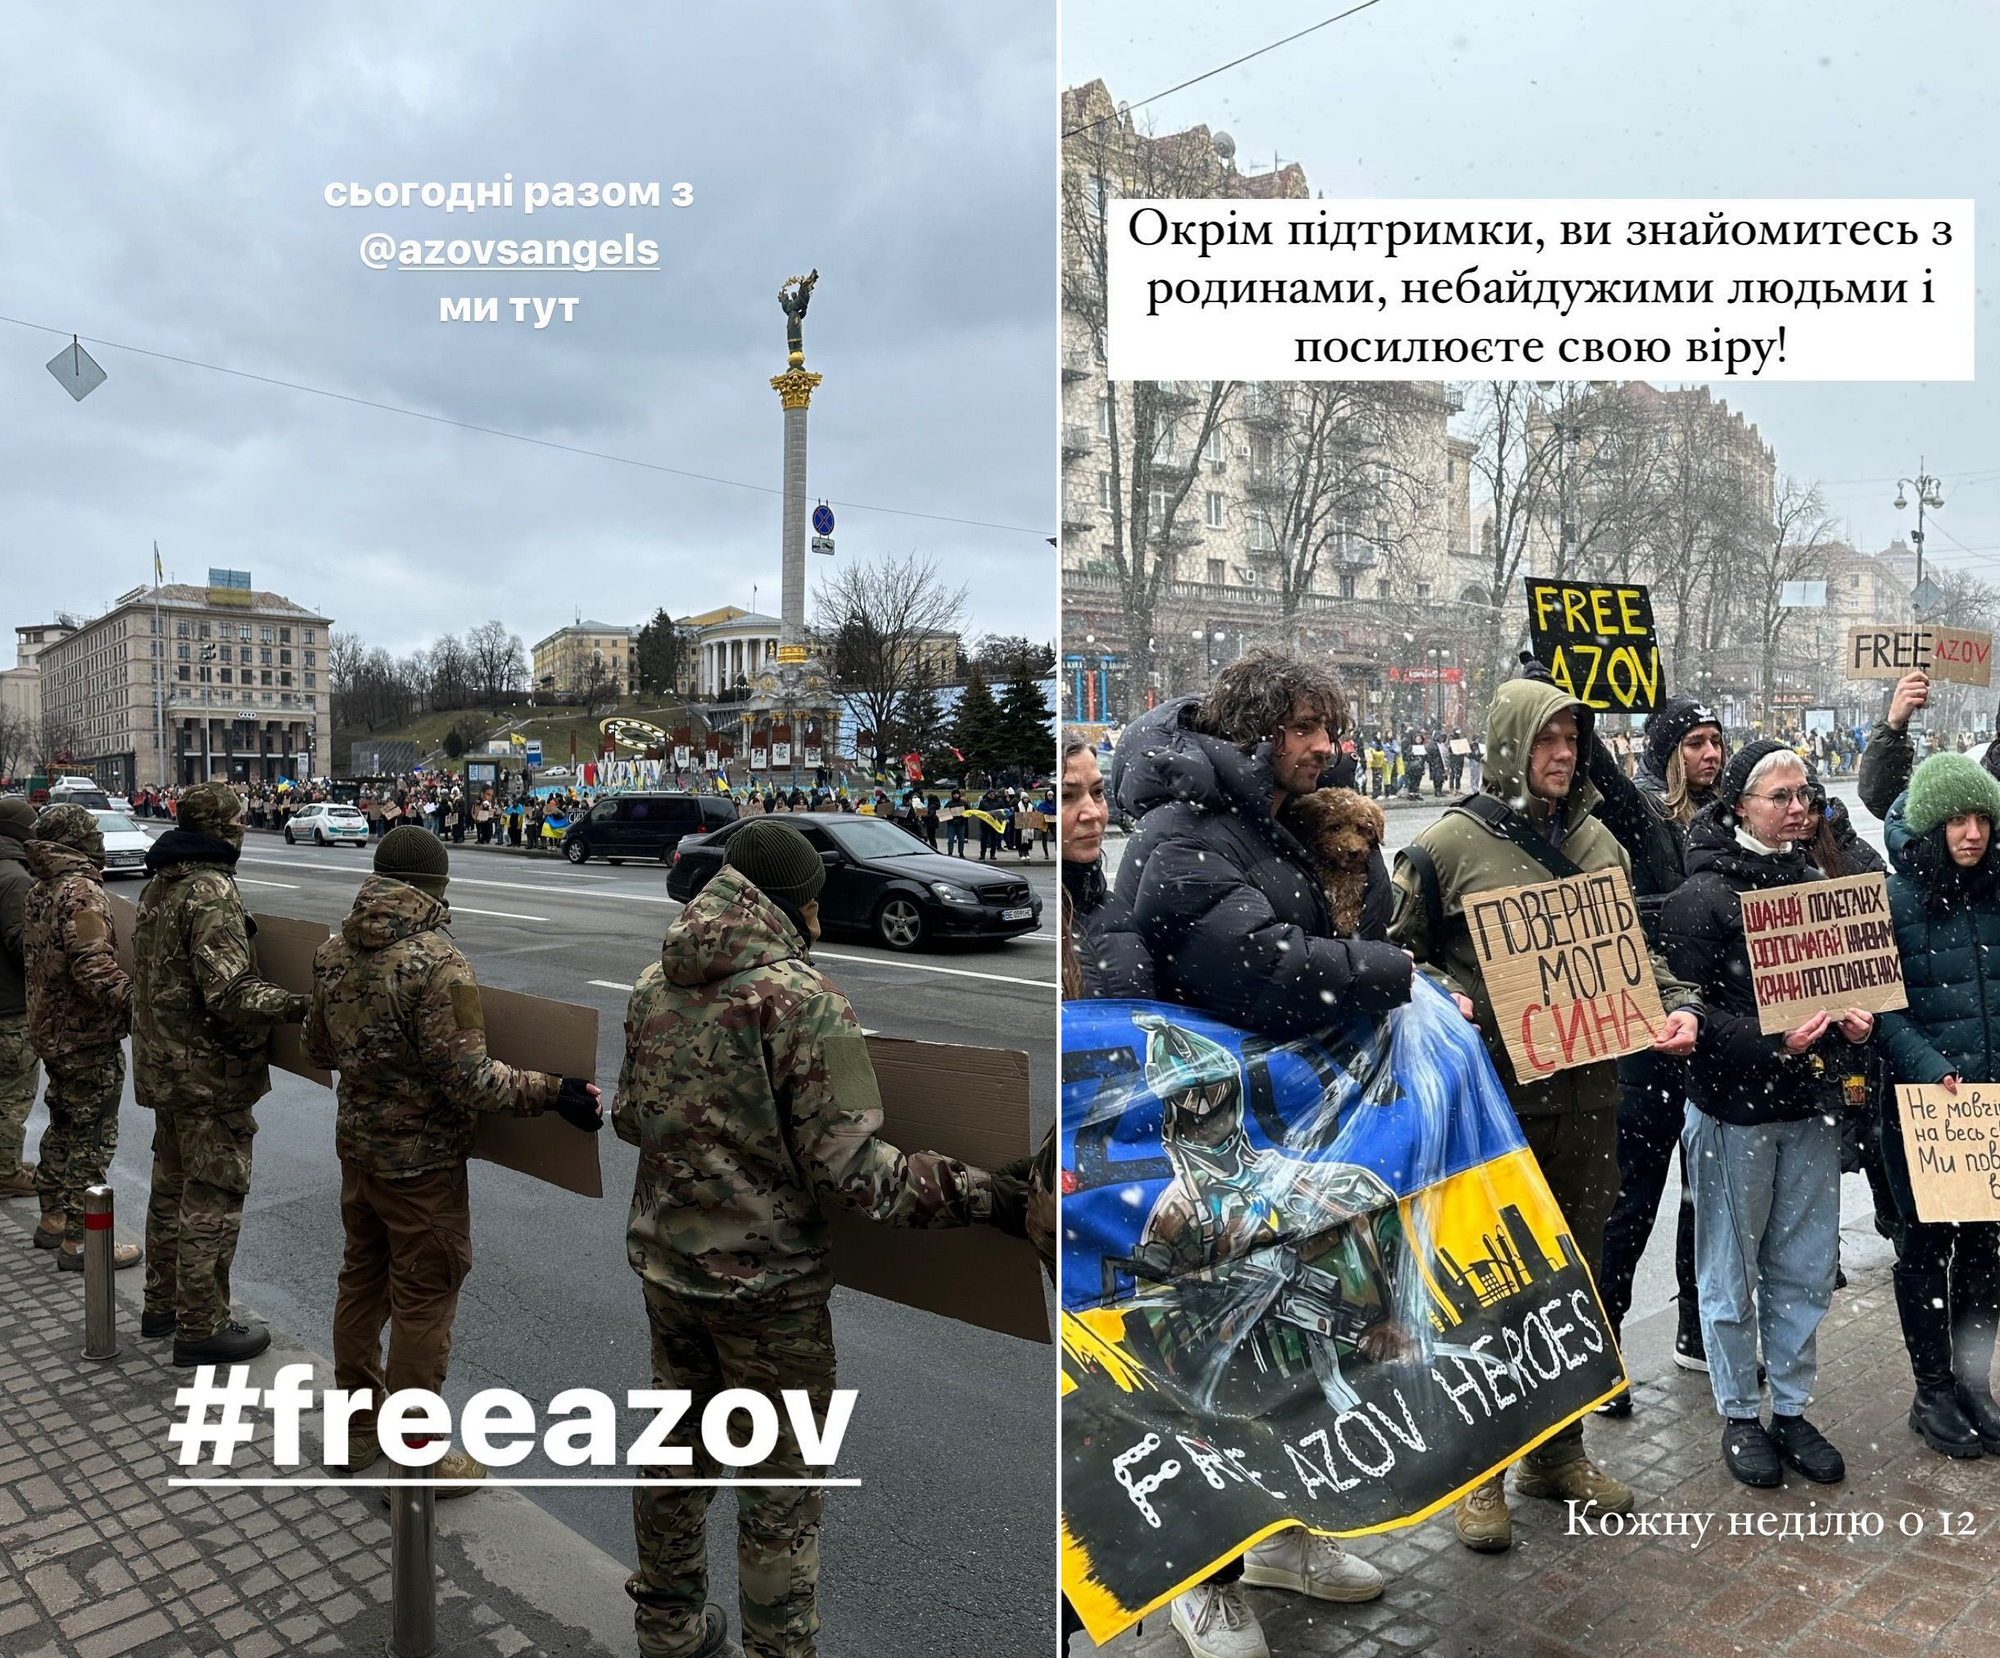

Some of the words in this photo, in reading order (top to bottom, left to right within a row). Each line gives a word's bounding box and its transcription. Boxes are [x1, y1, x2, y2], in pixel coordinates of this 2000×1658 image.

[1534, 586, 1648, 635] FREE
[1551, 644, 1658, 709] AZOV
[1854, 632, 1933, 669] FREE
[1935, 639, 1990, 665] AZOV
[1473, 874, 1634, 962] ПОВЕРНІТЬ
[1743, 891, 1804, 934] ШАНУЙ
[1538, 934, 1641, 1006] МОГО
[1750, 923, 1845, 970] ДОПОМАГАЙ
[1844, 917, 1898, 954] ЖИВИМ
[1755, 970, 1803, 1007] КРИЧИ
[1801, 966, 1830, 998] ПРО
[1828, 954, 1903, 994] ПОЛОНЕНИХ
[1522, 987, 1659, 1072] СИНА
[1906, 1087, 1938, 1120] Не
[1947, 1091, 2000, 1119] мовчі
[1914, 1127, 1939, 1142] на
[1944, 1118, 1985, 1142] весь
[1918, 1145, 1956, 1174] Ми
[1283, 1388, 1428, 1500] AZOV
[1430, 1287, 1605, 1426] HEROES
